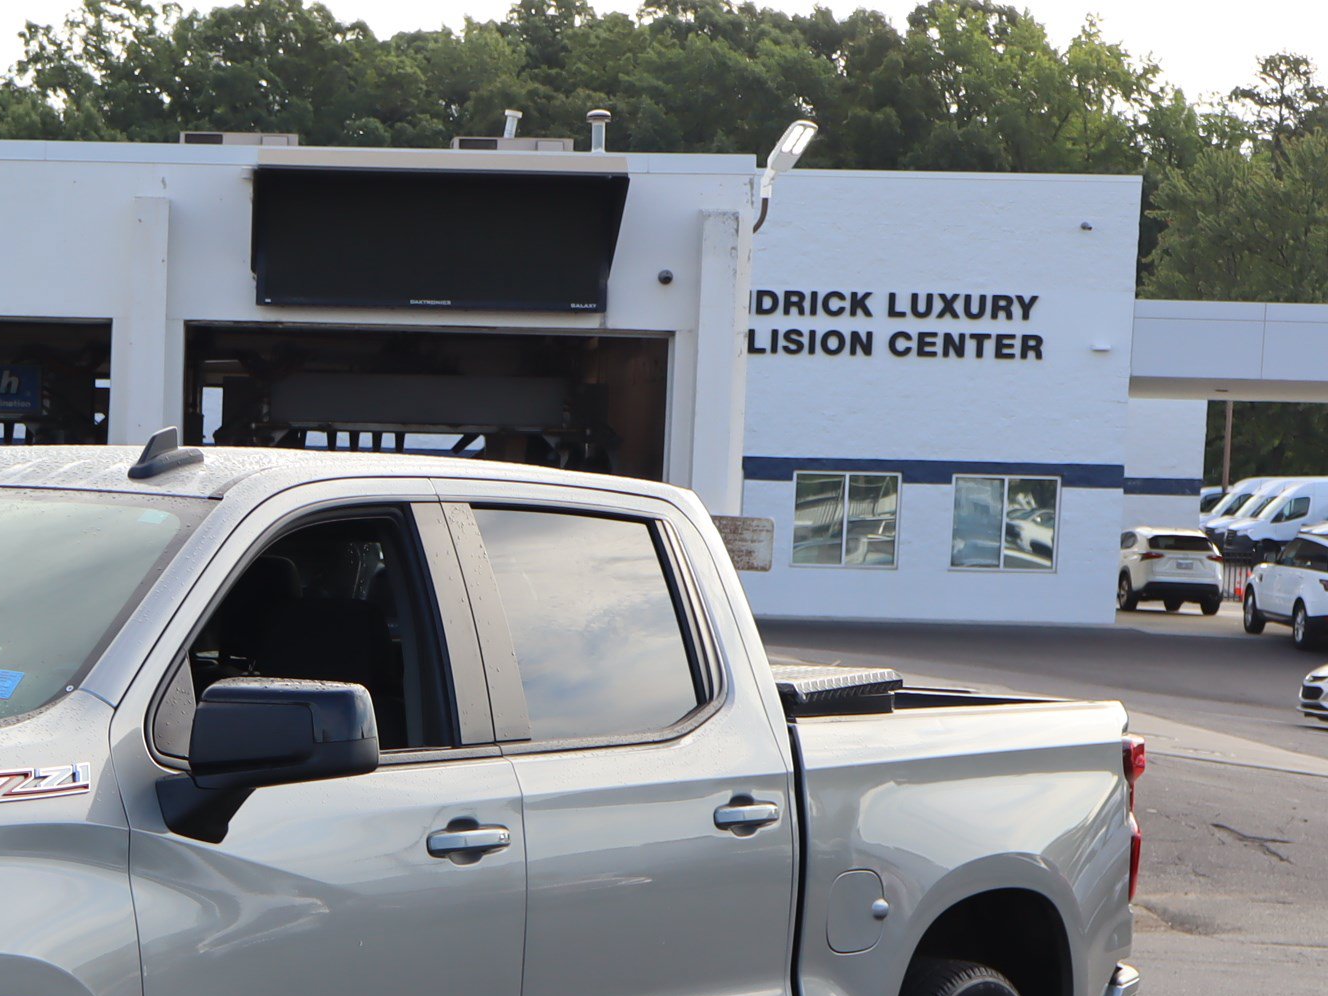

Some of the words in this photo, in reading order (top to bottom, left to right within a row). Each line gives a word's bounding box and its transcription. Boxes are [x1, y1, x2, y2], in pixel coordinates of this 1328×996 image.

[748, 289, 874, 318] DRICK
[887, 291, 1039, 321] LUXURY
[747, 328, 874, 356] LISION
[888, 331, 1044, 360] CENTER
